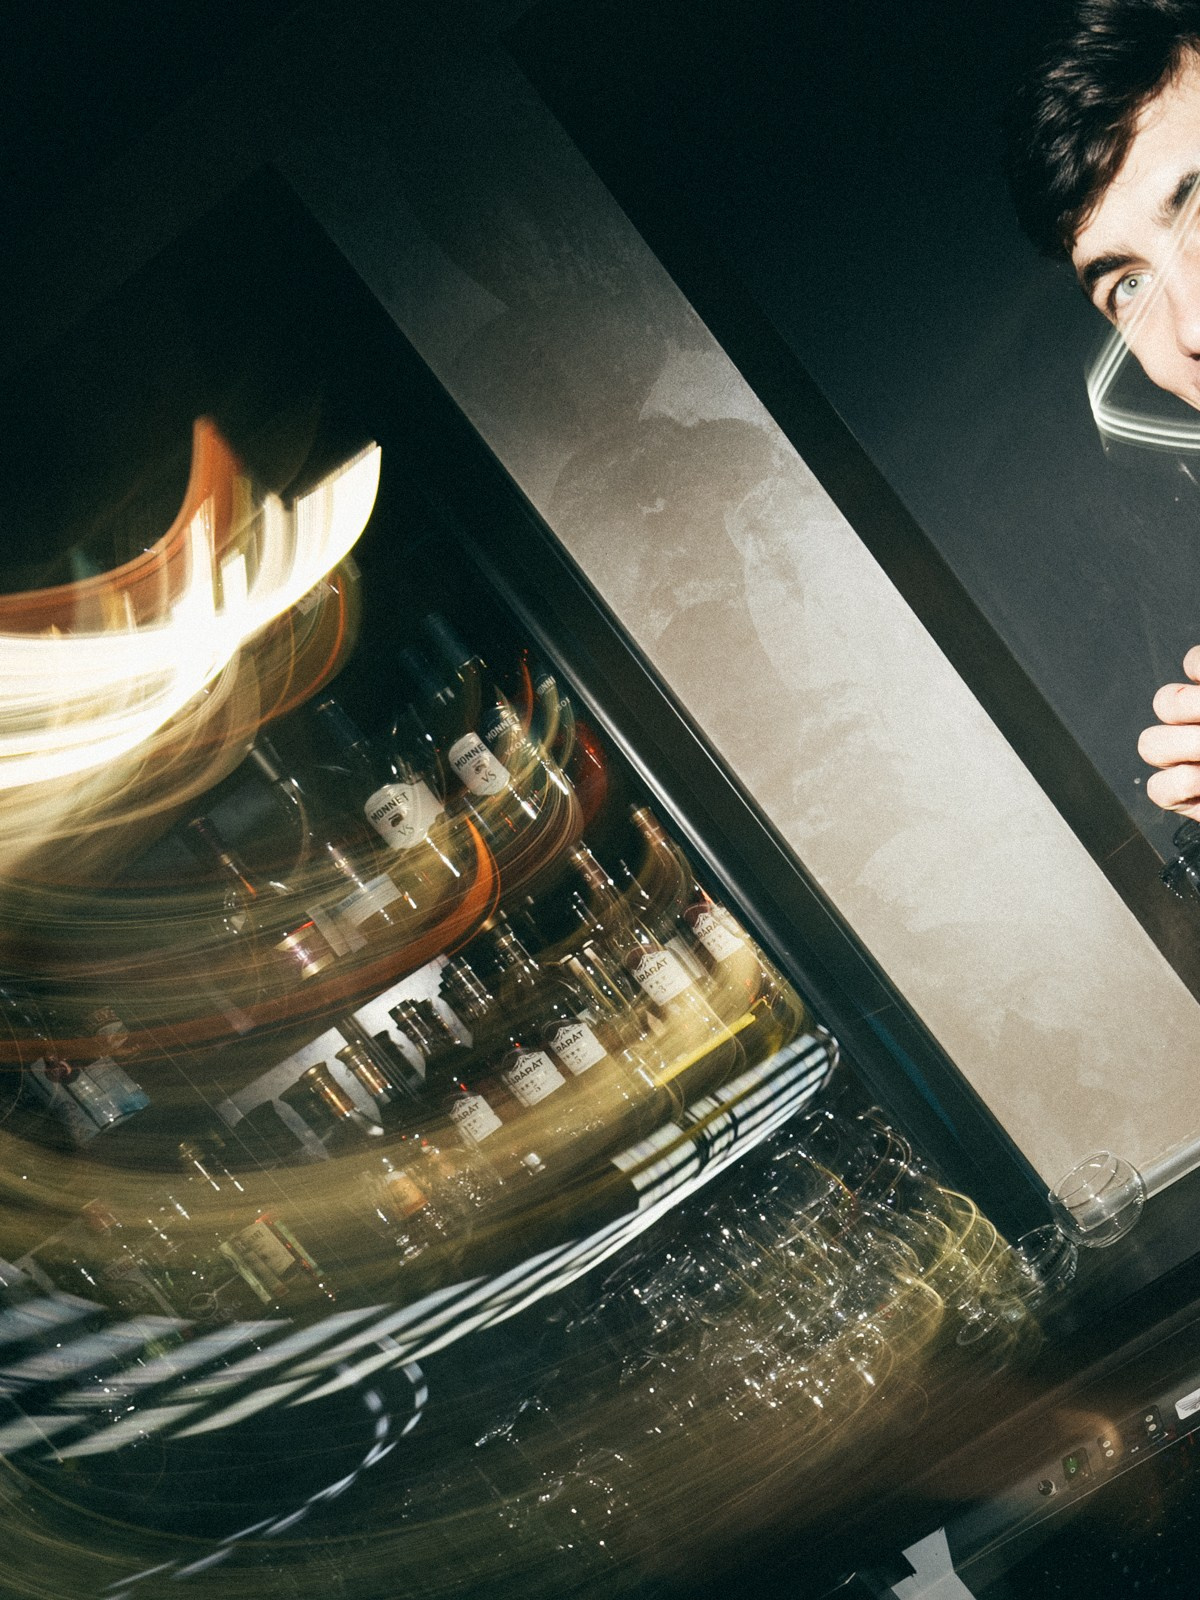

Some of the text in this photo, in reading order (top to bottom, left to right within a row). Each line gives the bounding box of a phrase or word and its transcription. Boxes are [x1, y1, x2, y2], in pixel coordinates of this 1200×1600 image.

[484, 712, 520, 743] MONNET
[481, 770, 497, 783] VS
[370, 791, 409, 824] MONNET
